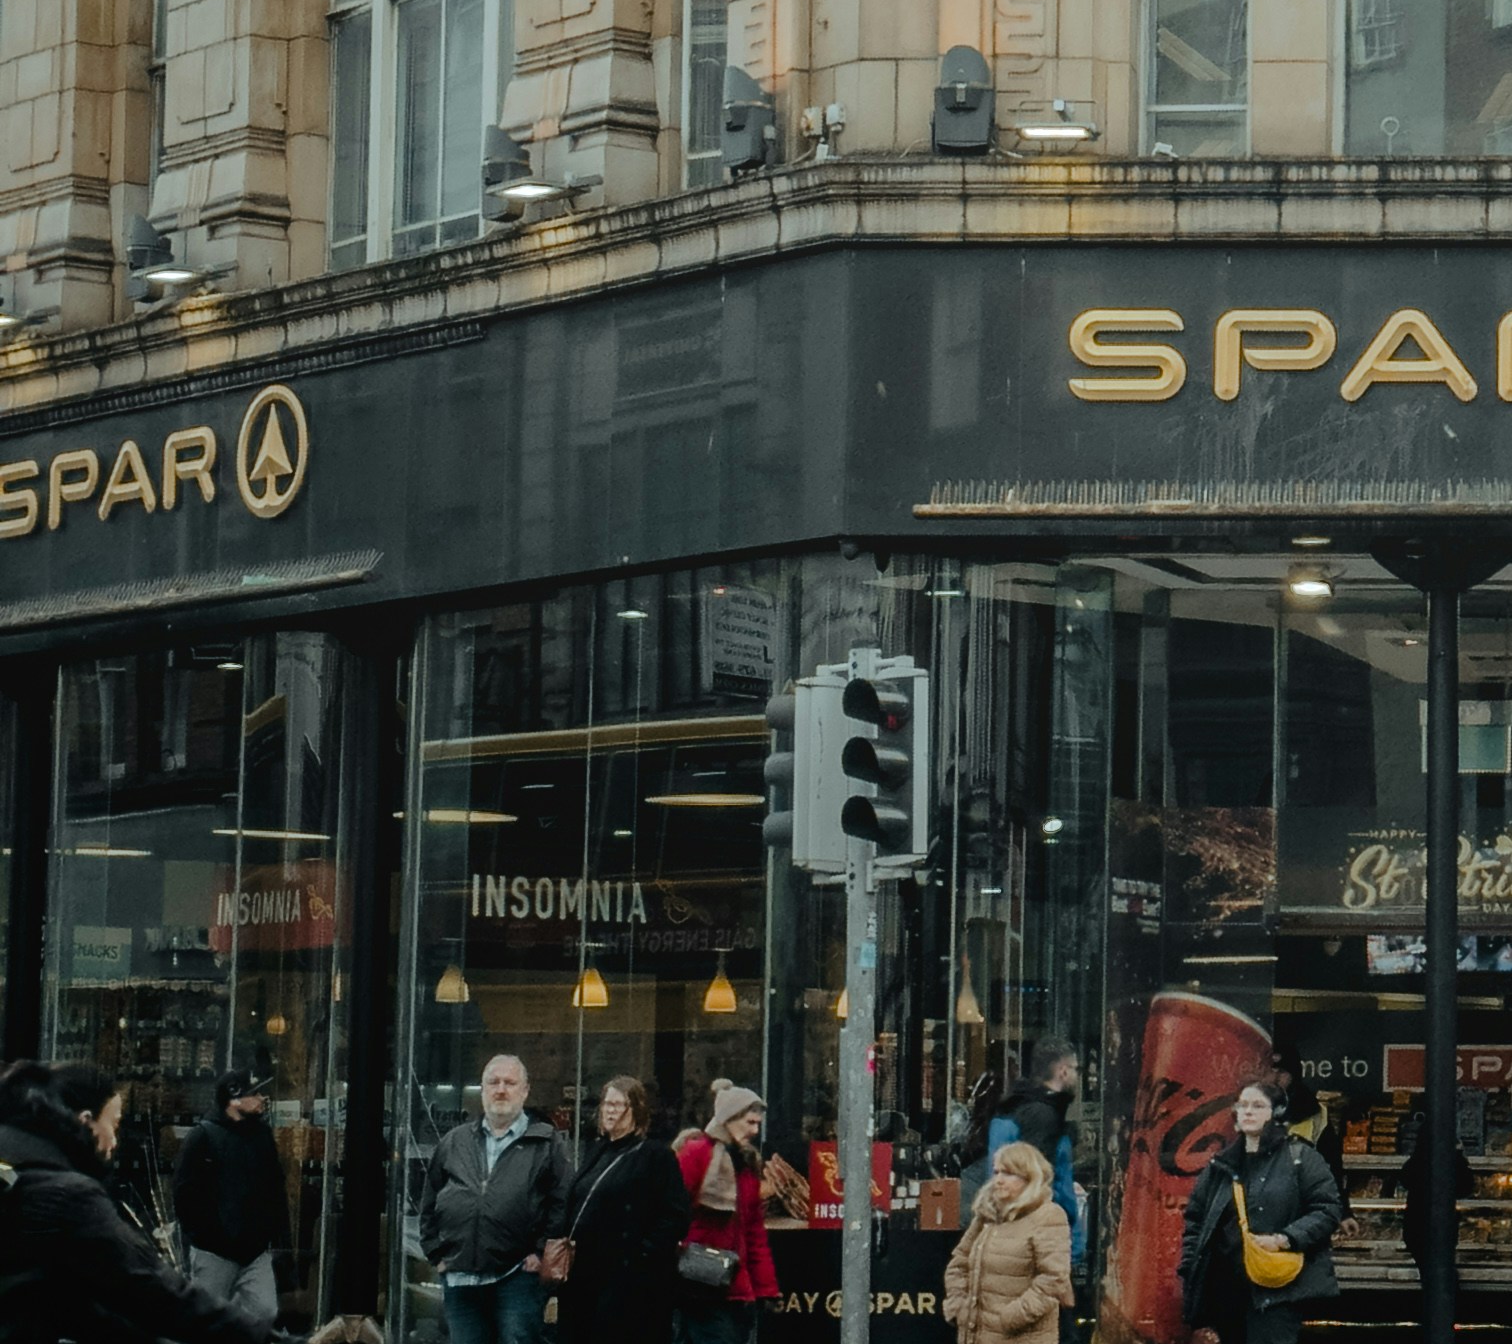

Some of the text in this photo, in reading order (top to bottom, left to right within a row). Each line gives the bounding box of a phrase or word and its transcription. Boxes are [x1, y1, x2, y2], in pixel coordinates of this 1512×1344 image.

[0, 425, 217, 539] SPAR
[1368, 829, 1417, 840] HAPPY
[1343, 844, 1409, 907] St
[216, 889, 301, 926] INSOMNIA
[471, 874, 648, 924] INSOMNIA
[1482, 903, 1511, 913] DAY
[1341, 1055, 1369, 1078] to
